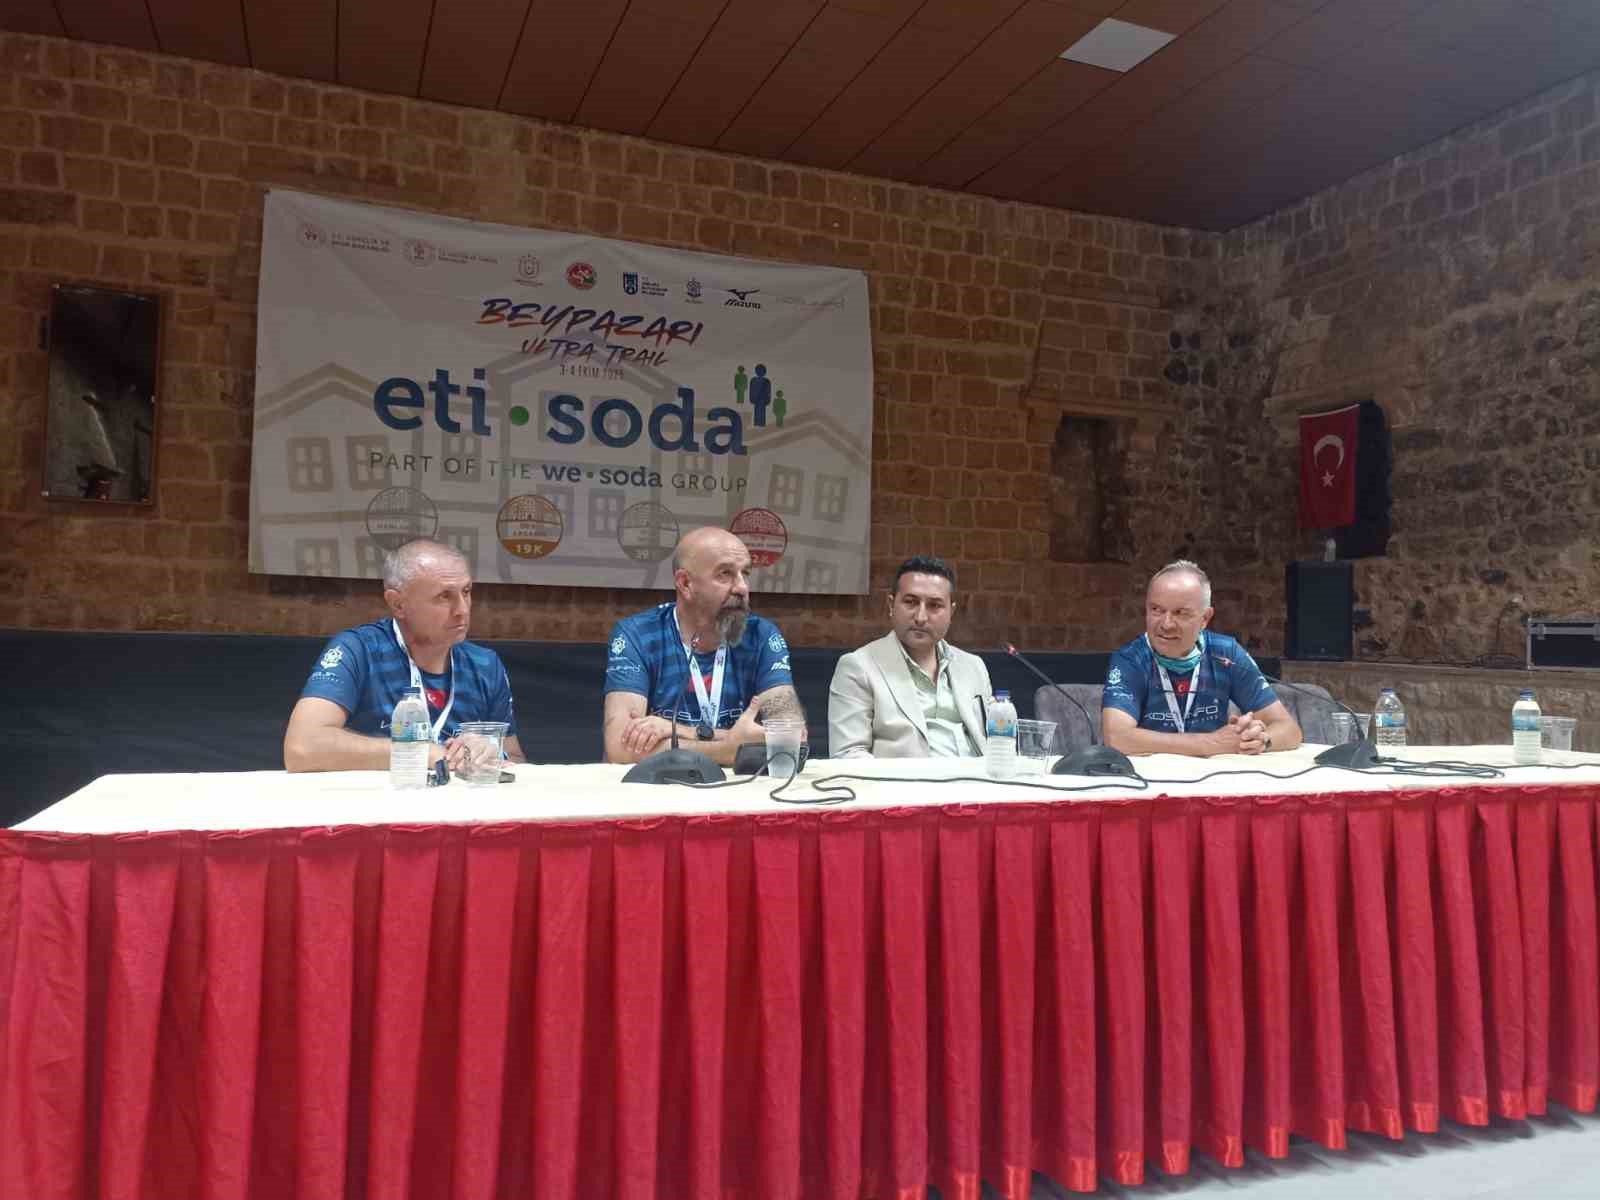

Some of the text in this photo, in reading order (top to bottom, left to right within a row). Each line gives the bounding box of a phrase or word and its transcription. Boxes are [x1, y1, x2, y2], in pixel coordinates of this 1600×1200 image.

[476, 298, 705, 346] BEYPAZARI
[522, 338, 670, 367] ULTRA TRAIL
[373, 368, 748, 457] eti soda
[369, 452, 748, 493] PART OF THE we soda GROUP
[515, 543, 544, 555] 19K
